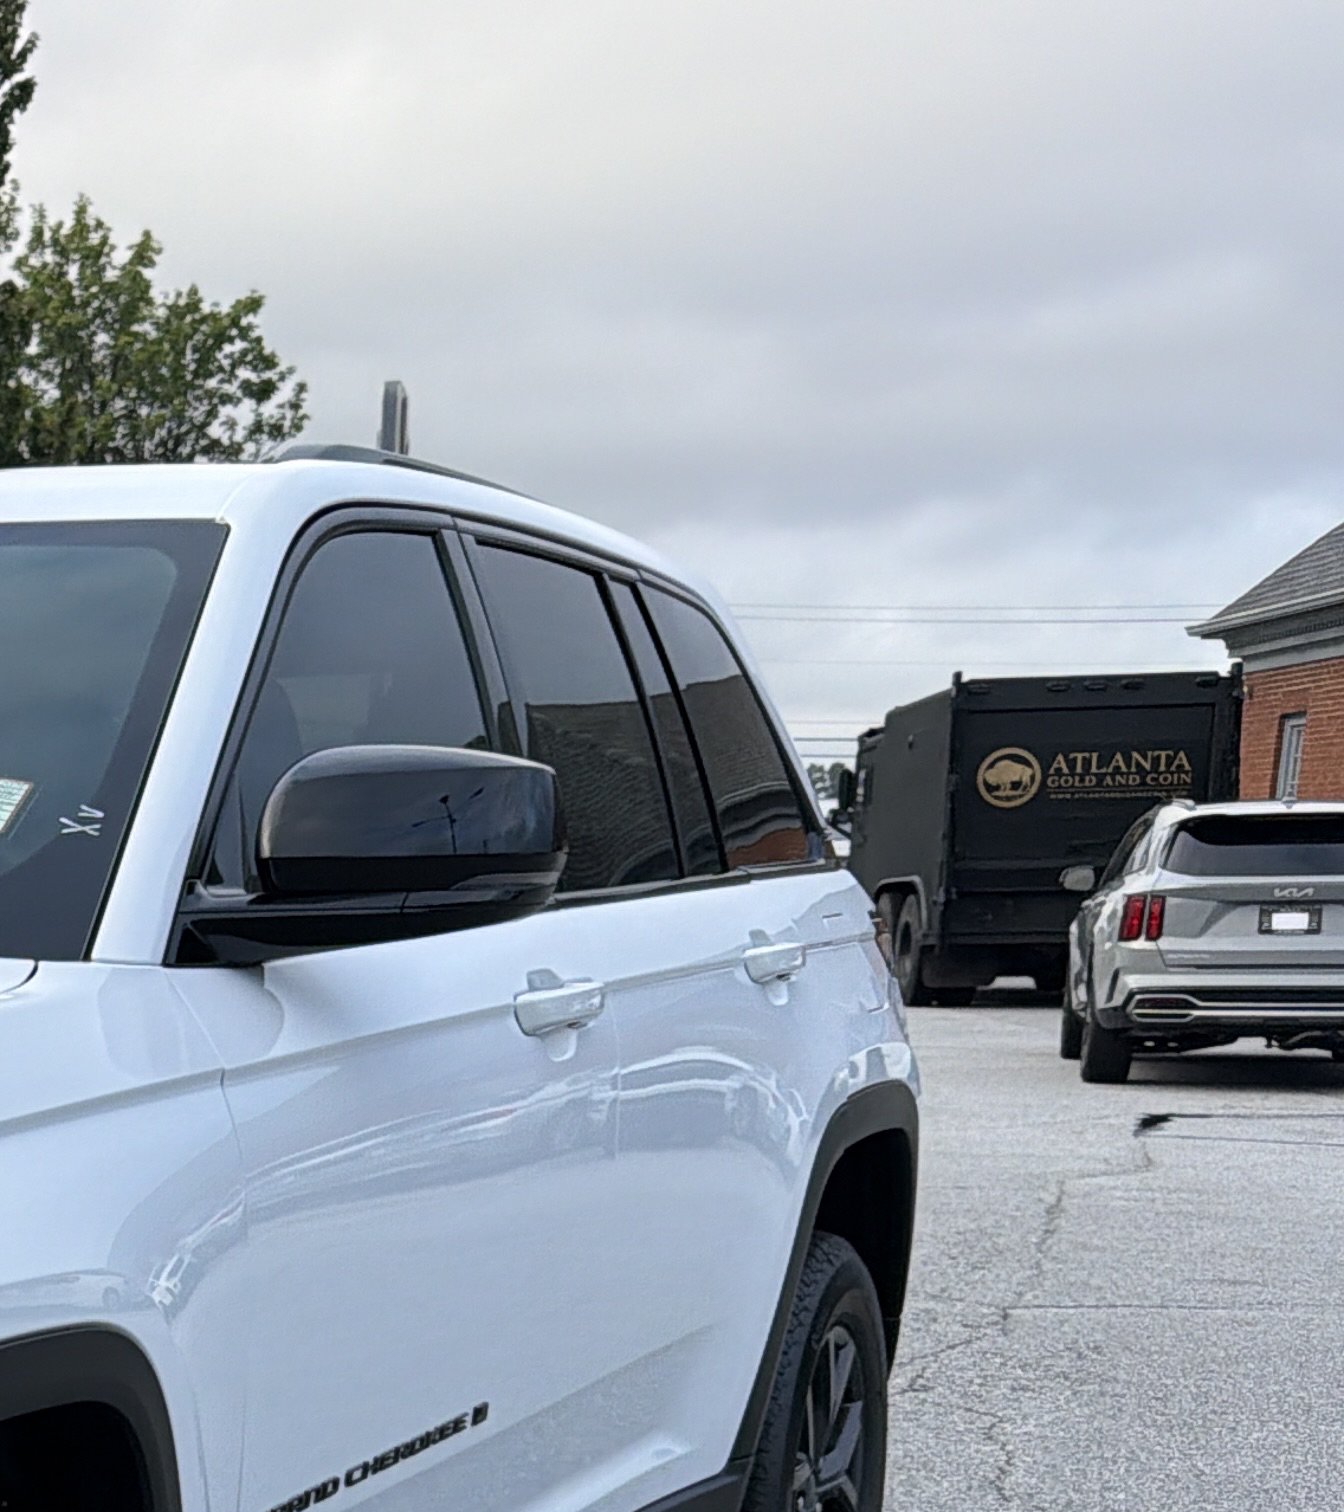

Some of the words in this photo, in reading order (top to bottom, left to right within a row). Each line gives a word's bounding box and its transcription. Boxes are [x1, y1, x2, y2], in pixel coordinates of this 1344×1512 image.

[1048, 750, 1192, 775] ATLANTA
[1047, 775, 1097, 788] GOLD
[1103, 773, 1141, 787] AND
[1146, 772, 1192, 785] COIN
[343, 1411, 470, 1488] CHEROKEE
